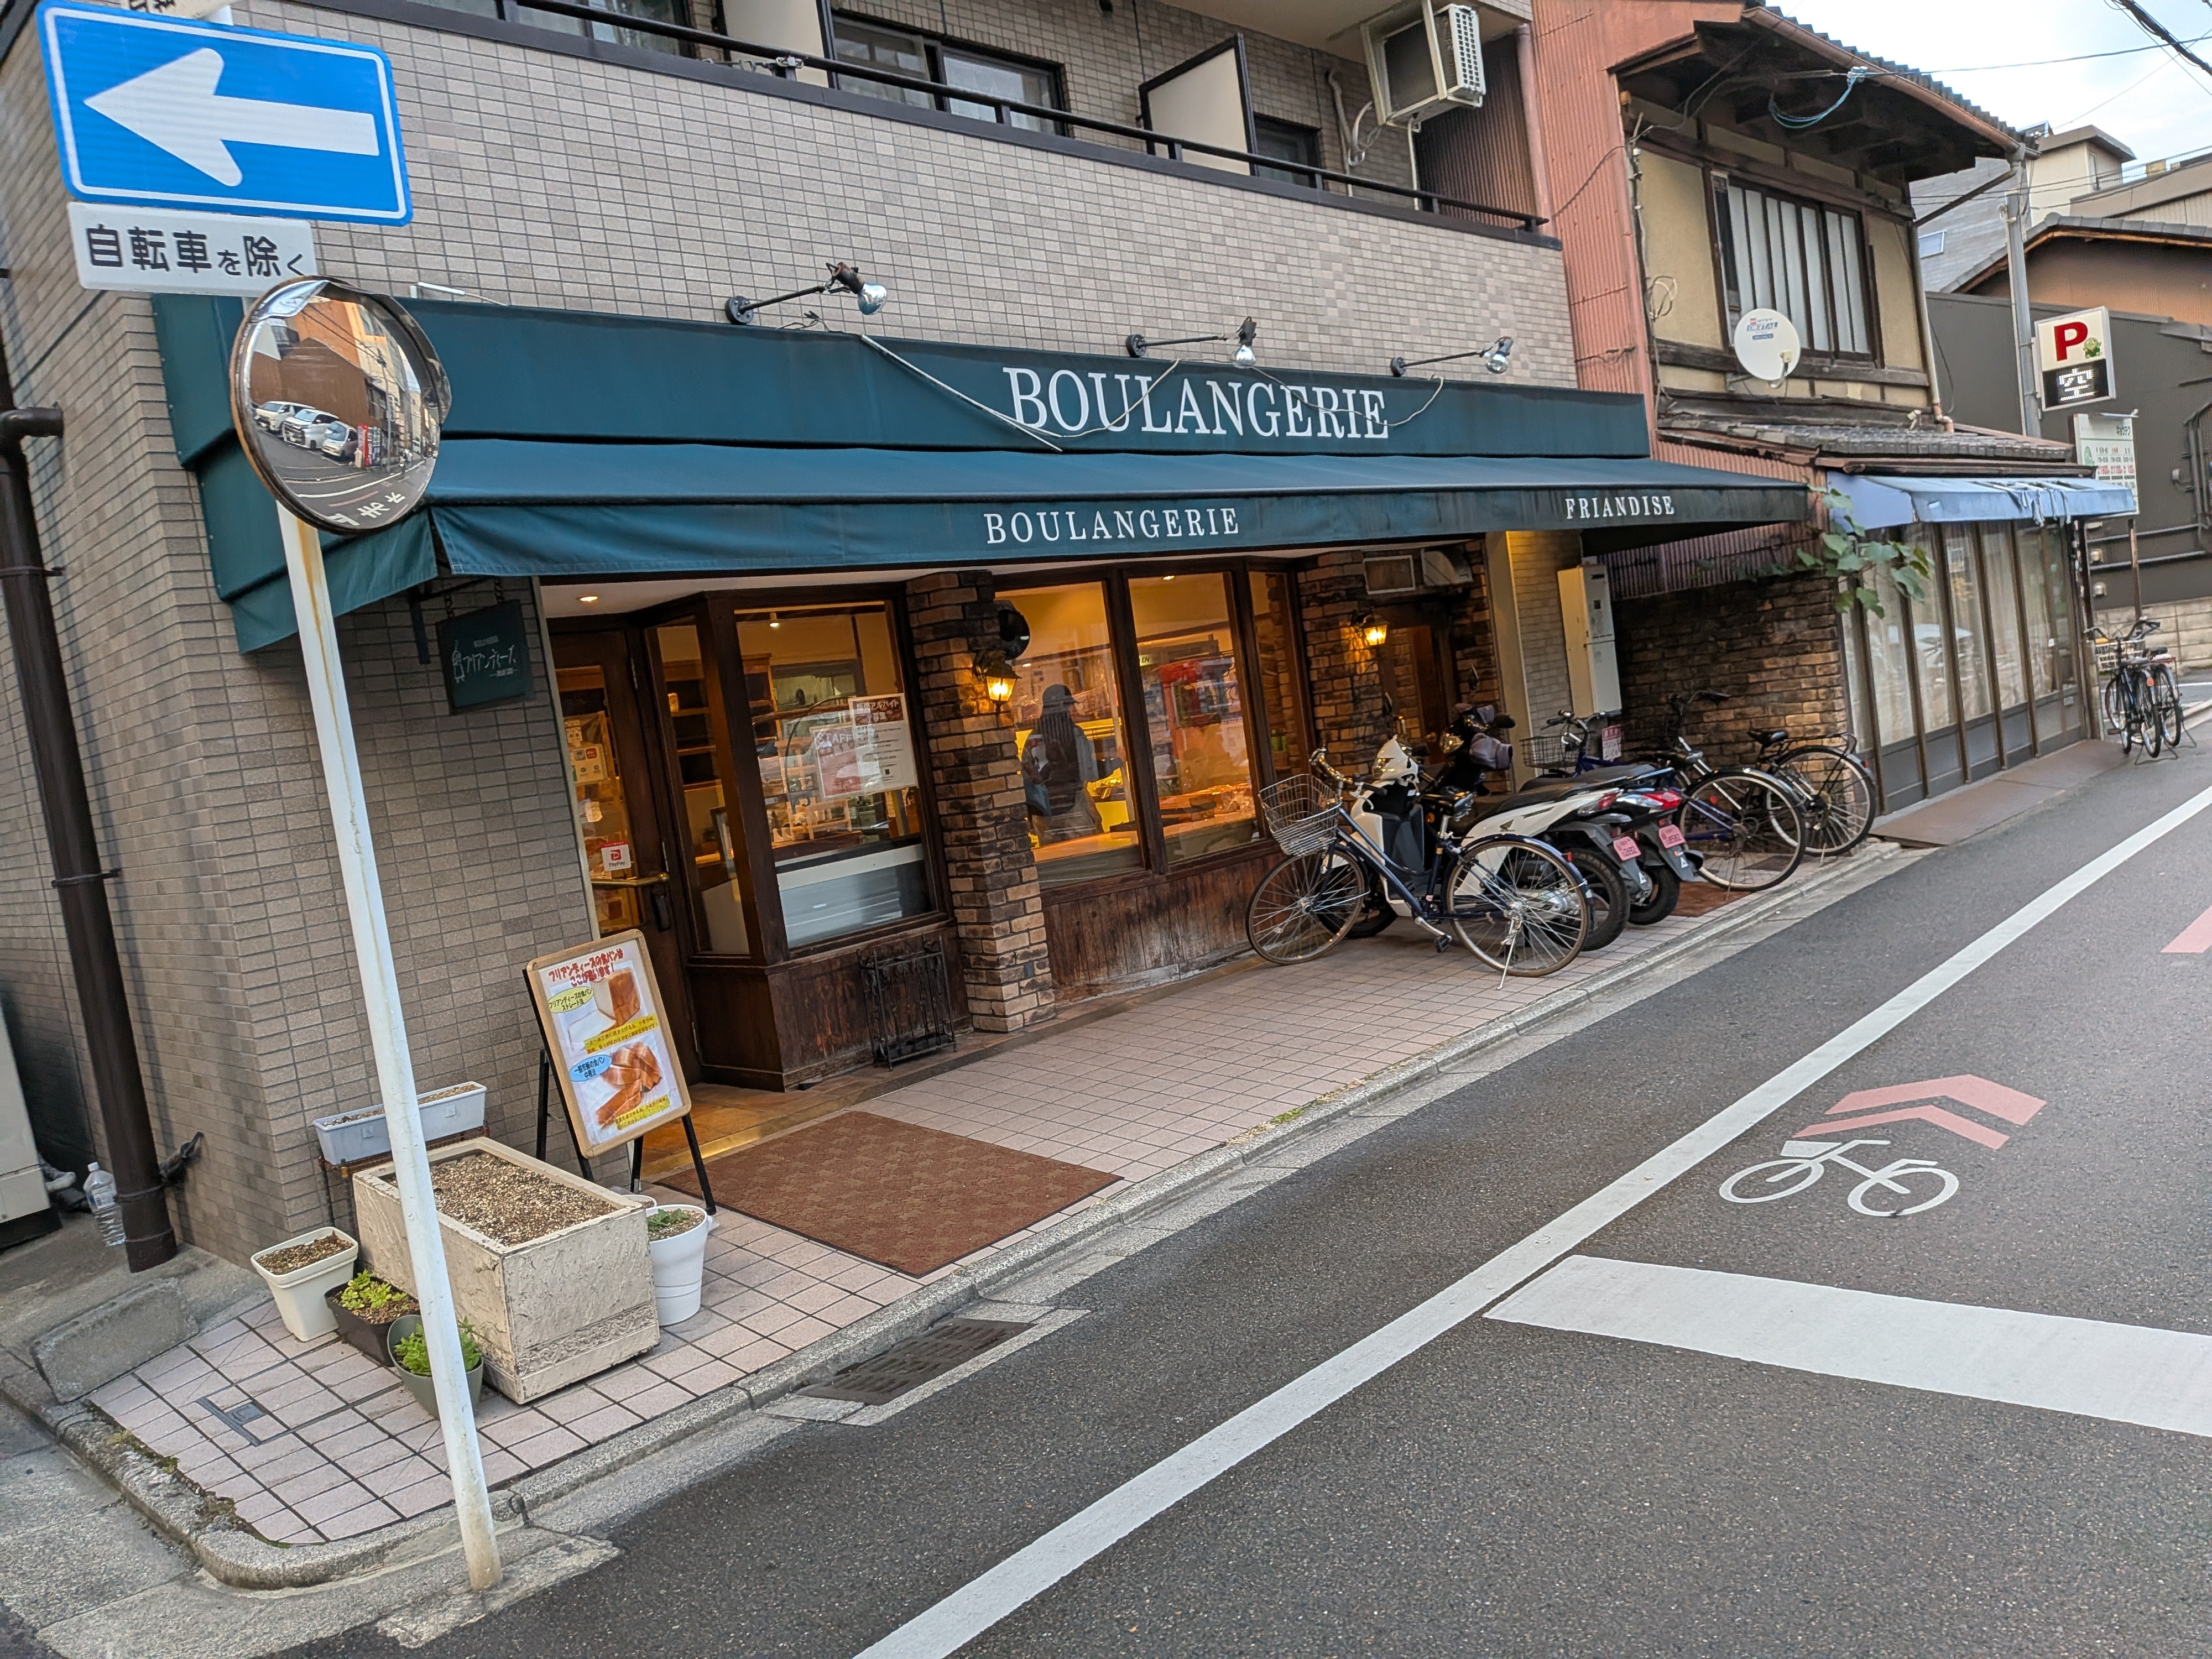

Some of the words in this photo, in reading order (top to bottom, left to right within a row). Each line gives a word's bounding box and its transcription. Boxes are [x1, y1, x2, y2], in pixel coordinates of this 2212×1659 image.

[87, 223, 304, 276] 自転車を除く
[2054, 322, 2088, 362] P
[1003, 367, 1389, 439] BOULANGERIE
[2058, 368, 2095, 401] 空
[983, 508, 1239, 544] BOULANGERIE
[1565, 496, 1674, 519] FRIANDISE
